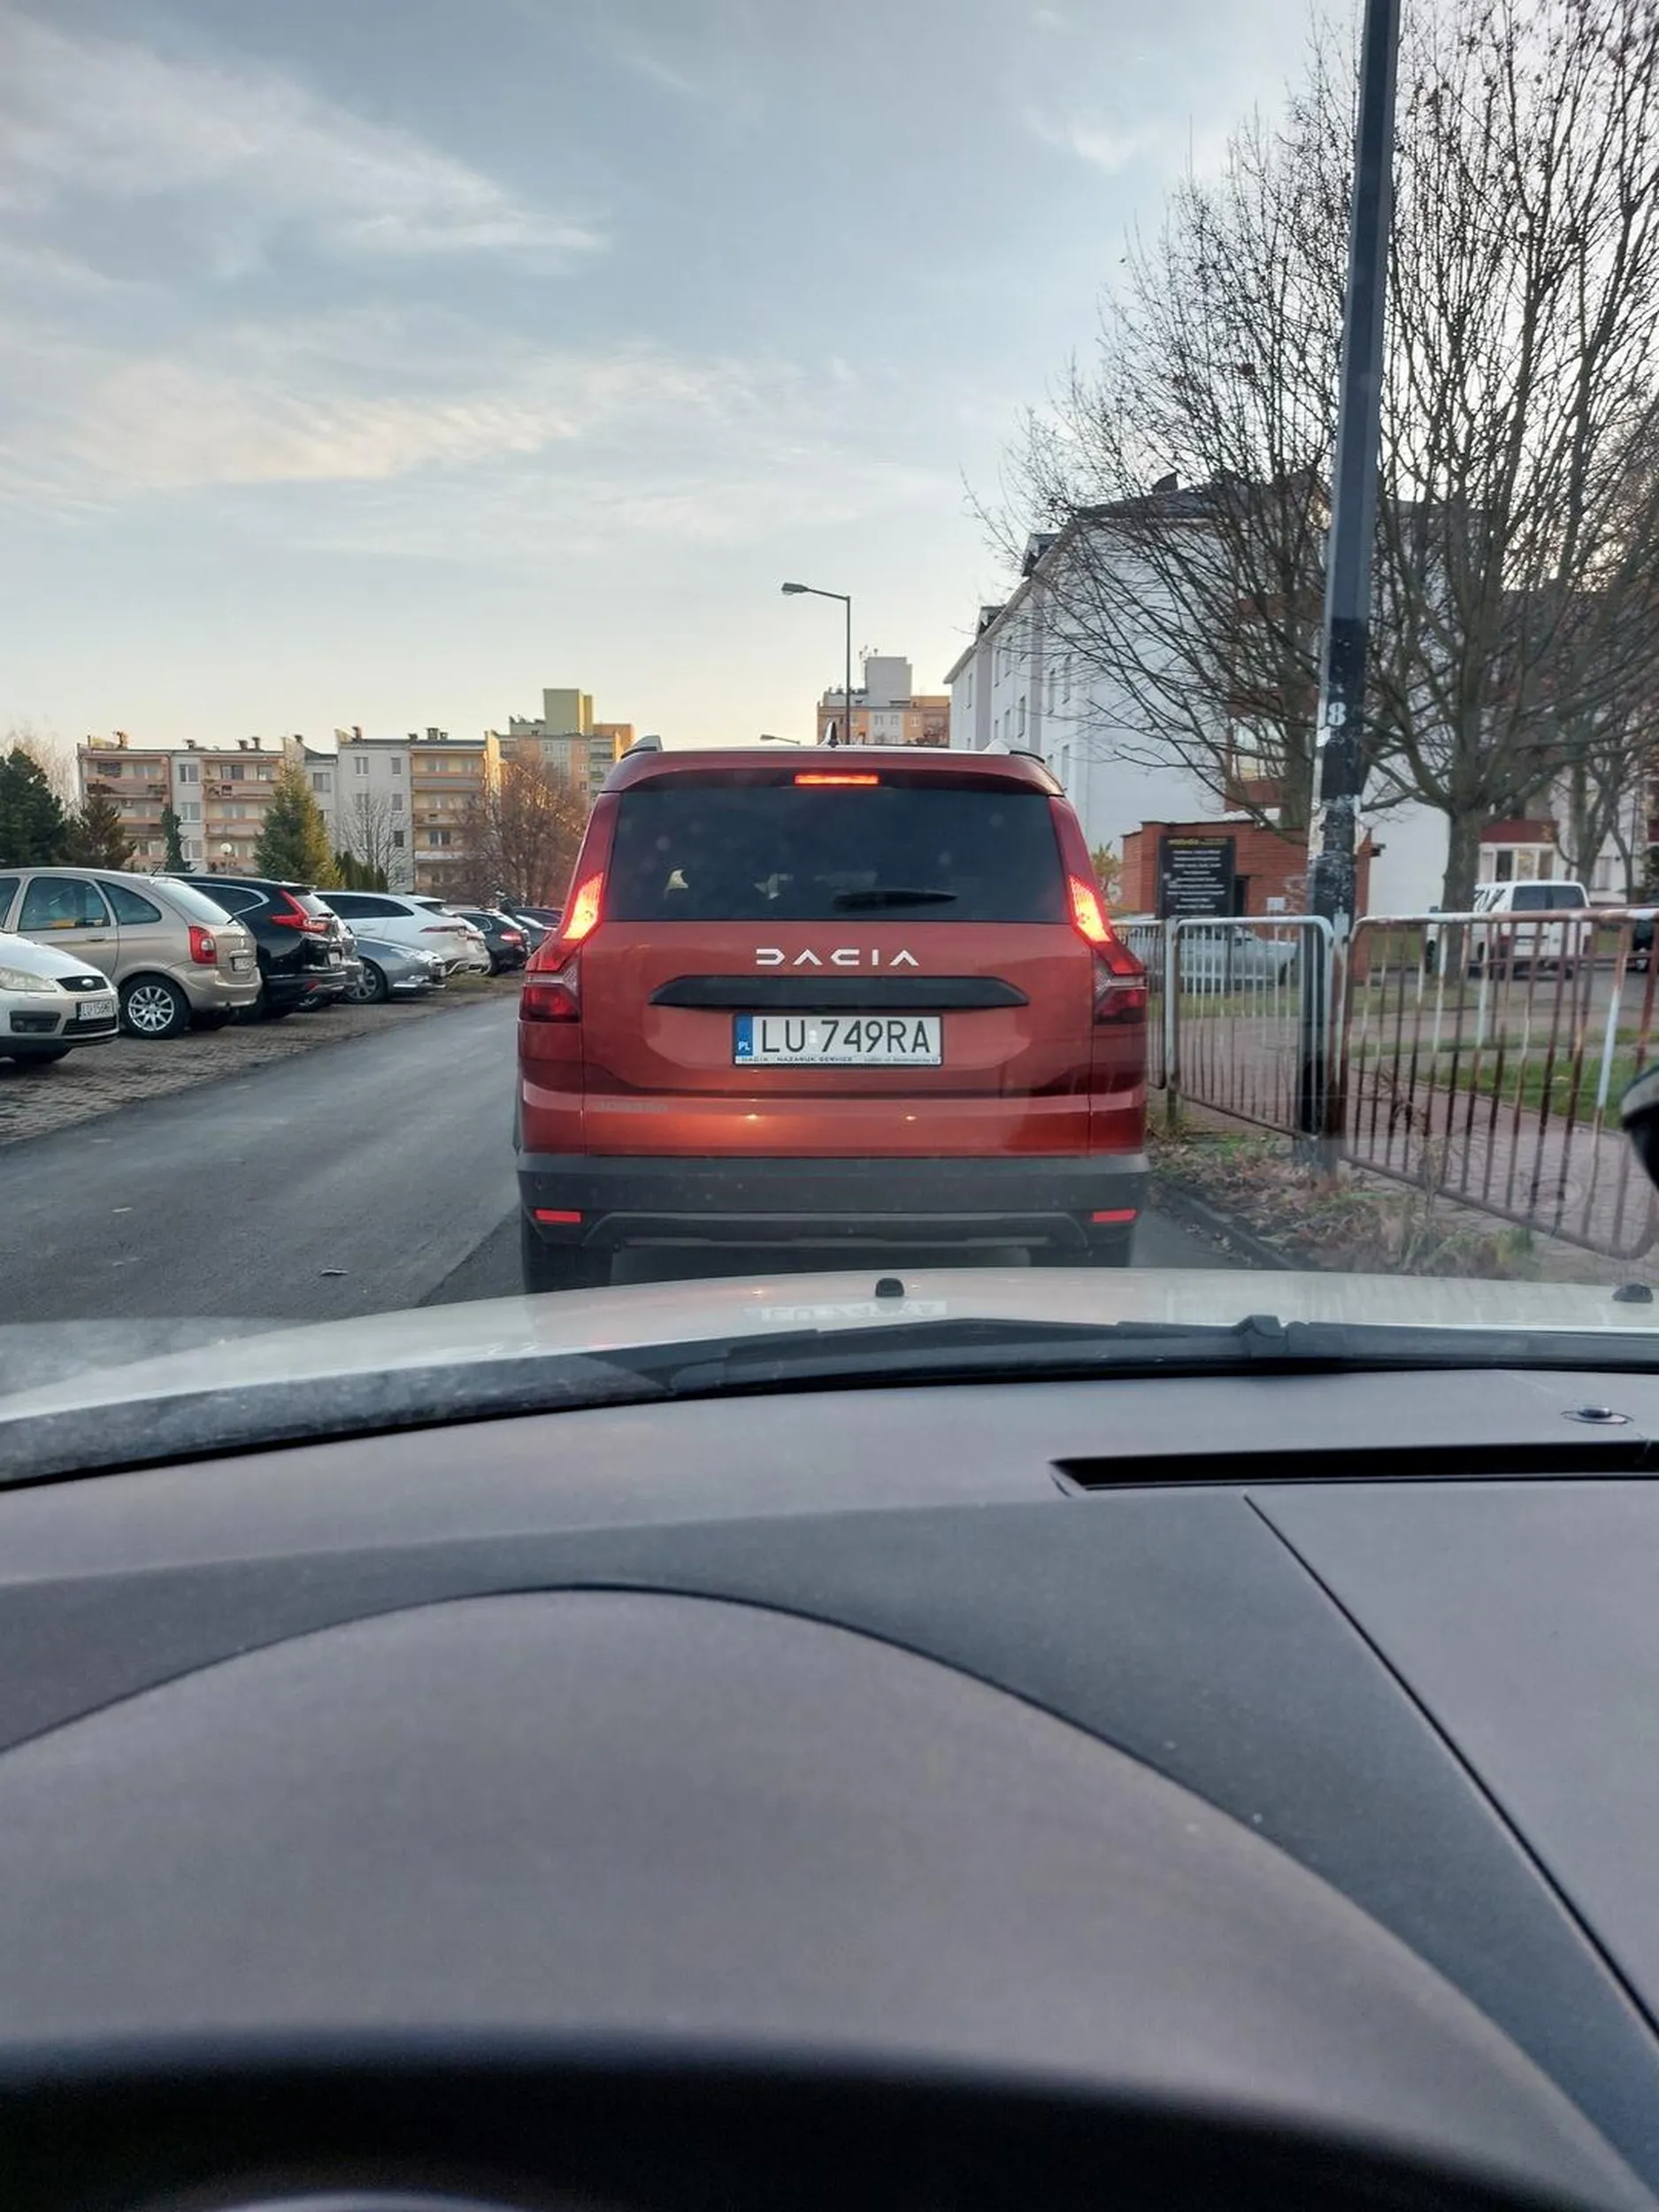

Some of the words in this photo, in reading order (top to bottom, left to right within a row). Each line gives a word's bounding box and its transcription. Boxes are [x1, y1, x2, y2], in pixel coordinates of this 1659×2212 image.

[1327, 702, 1347, 726] 8
[756, 949, 919, 966] DACIA
[738, 1041, 750, 1051] PL
[762, 1019, 805, 1053] LU
[821, 1019, 930, 1053] 749RA
